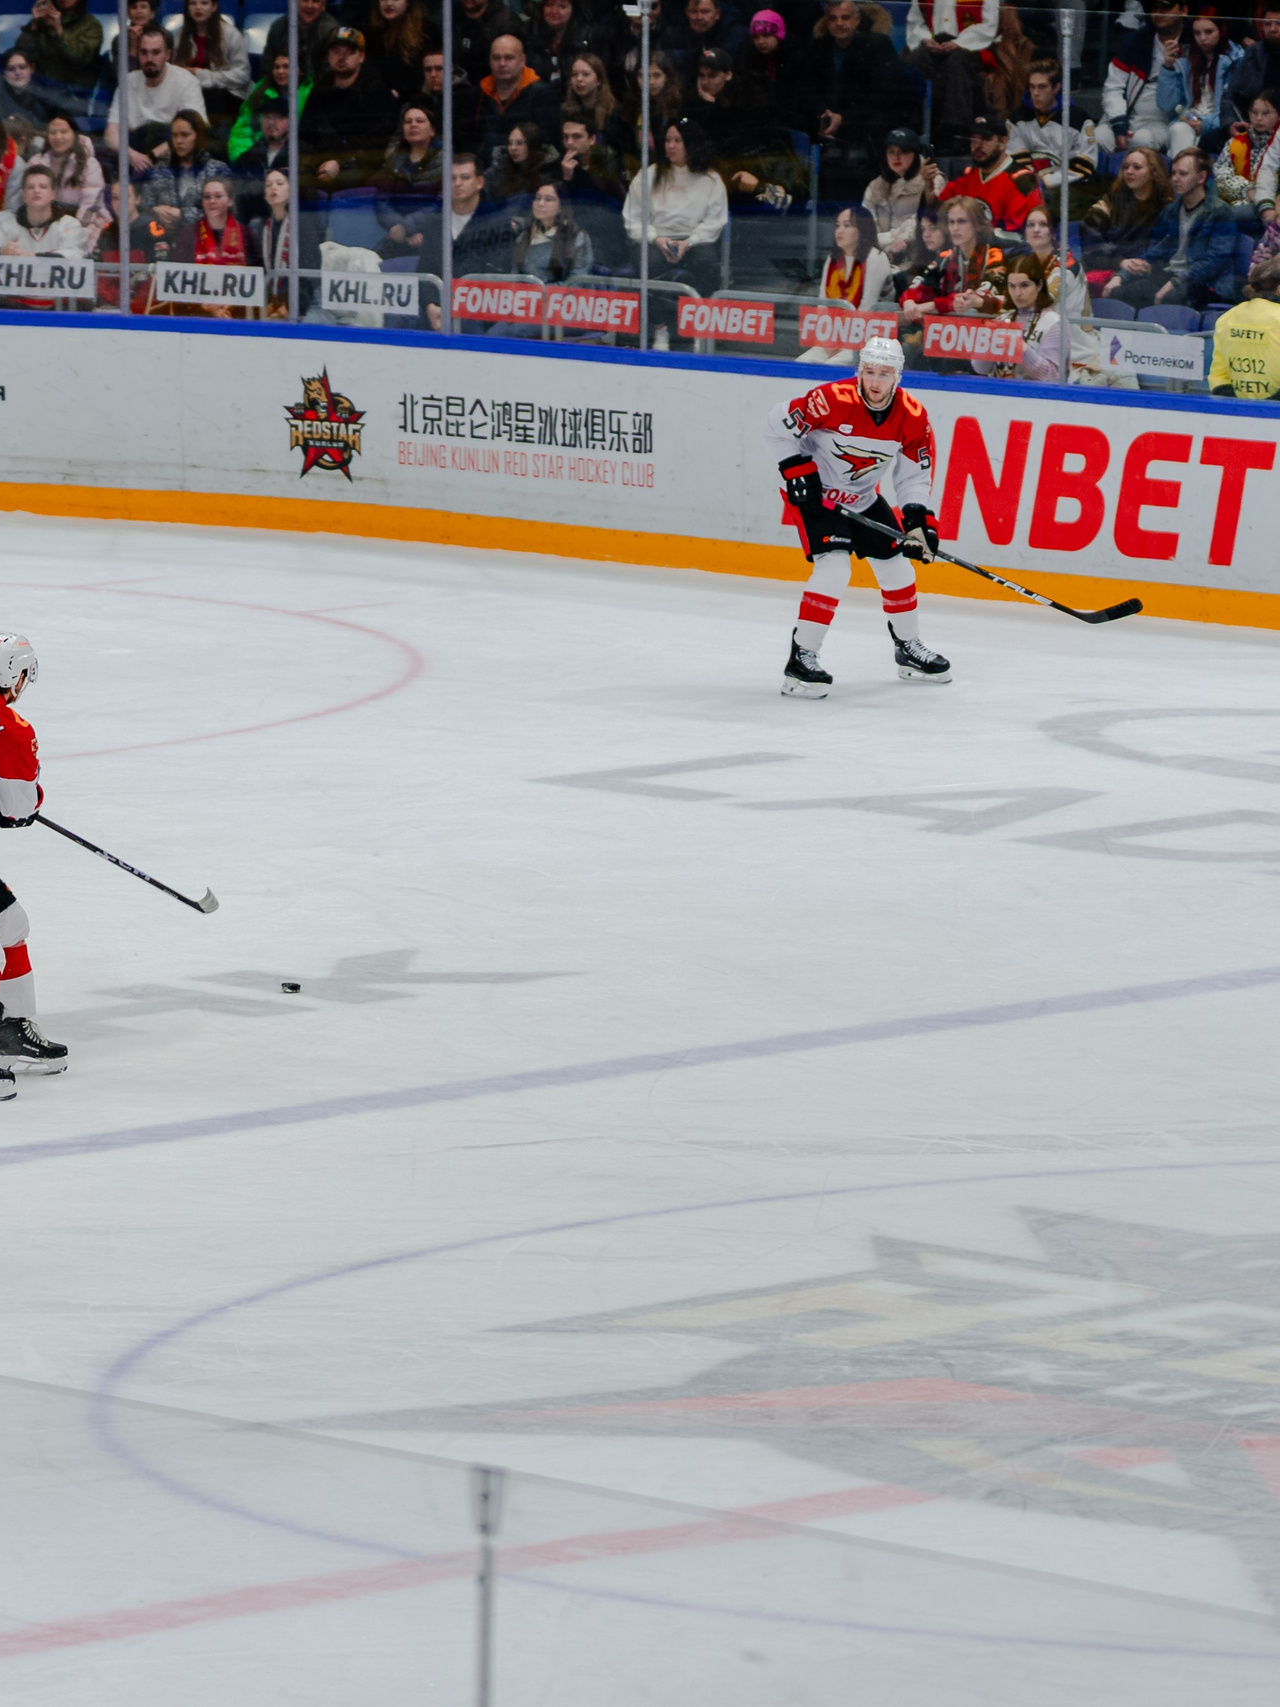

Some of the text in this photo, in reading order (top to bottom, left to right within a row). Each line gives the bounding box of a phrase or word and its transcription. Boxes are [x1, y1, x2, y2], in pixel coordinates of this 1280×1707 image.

[162, 269, 257, 299] KHL.RU
[327, 278, 413, 308] KHL.RU
[452, 286, 543, 318] FONBET
[546, 293, 638, 326] FONBET
[678, 302, 774, 337] FONBET
[801, 312, 898, 347] FONBET
[1230, 327, 1266, 341] SAFETY
[924, 322, 1022, 357] FONBET
[1124, 350, 1194, 371] Ростелеком
[1231, 380, 1270, 394] AFETY
[287, 418, 366, 455] REDSTAR
[398, 393, 653, 454] 北京昆仑鸿星冰球俱乐部
[398, 440, 655, 488] BEIJING KUNLUN RED STAR HOCKEY CLUB
[918, 446, 931, 470] 5
[988, 572, 1053, 607] TRUE
